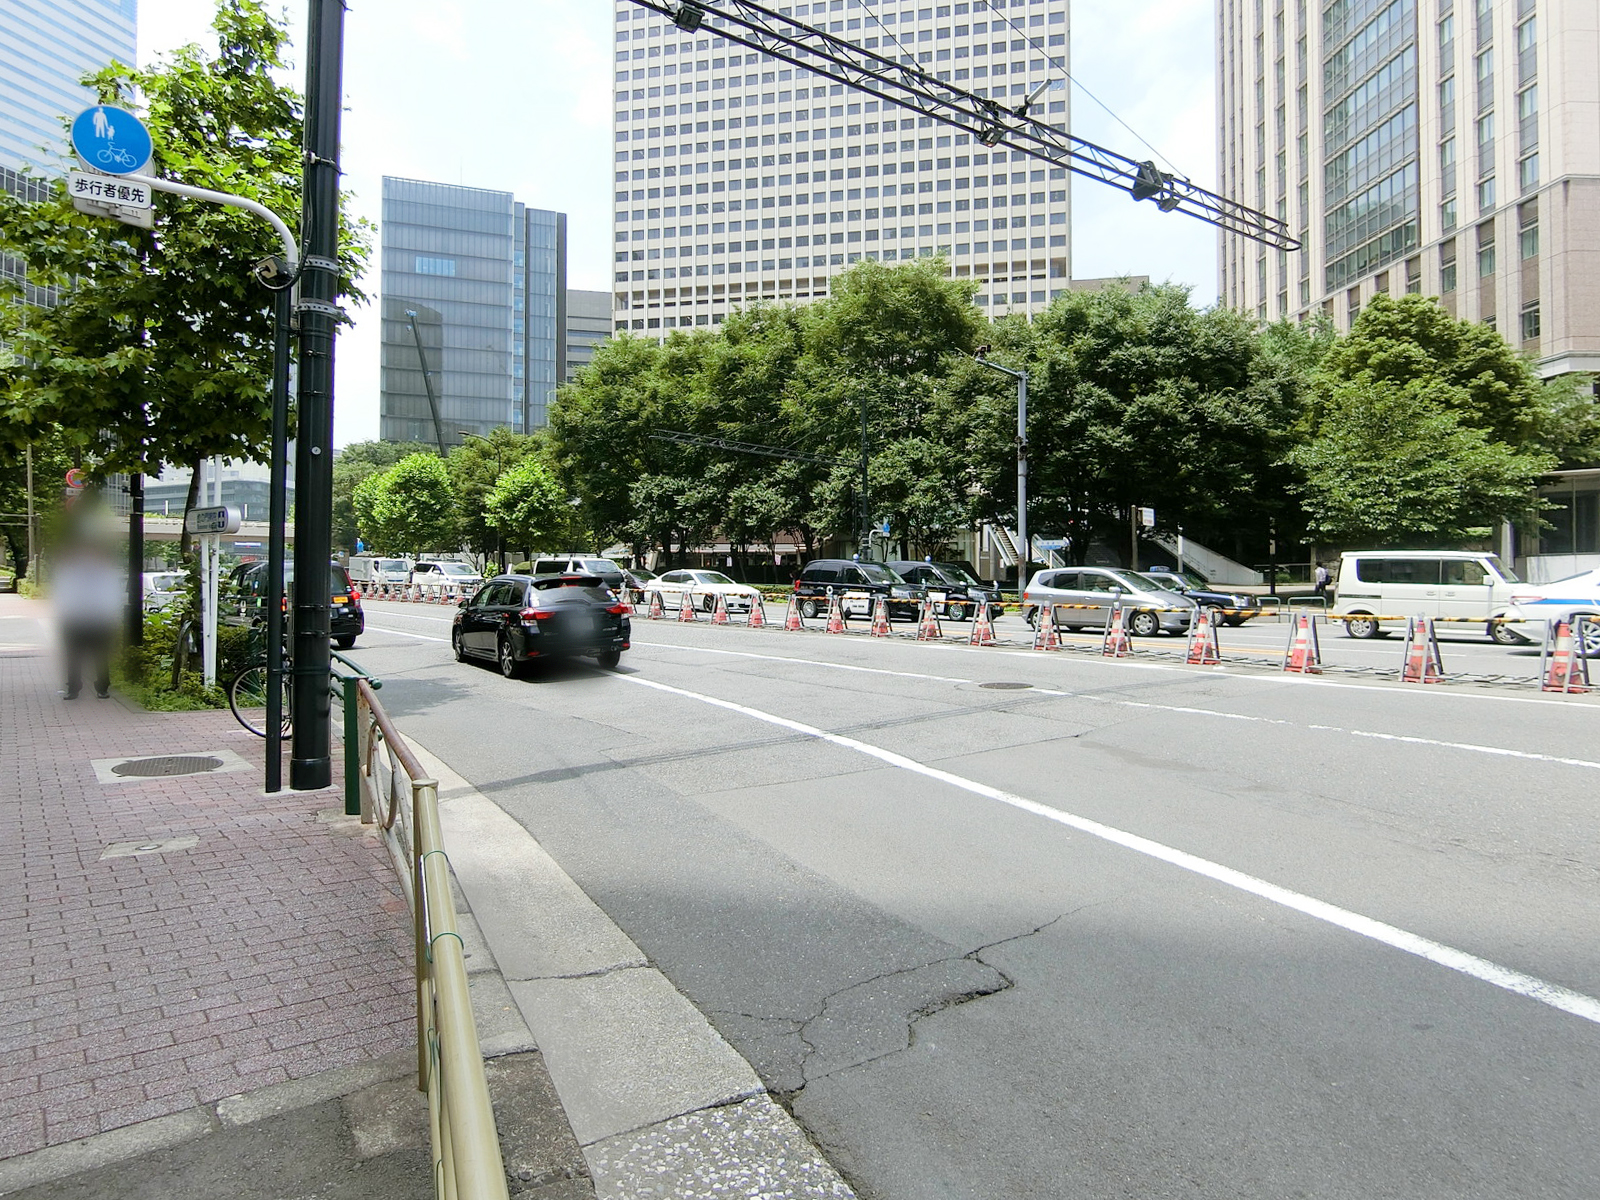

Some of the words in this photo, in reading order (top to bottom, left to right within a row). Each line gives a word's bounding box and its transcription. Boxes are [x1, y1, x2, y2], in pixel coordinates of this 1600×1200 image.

[75, 178, 145, 203] 歩行者優先
